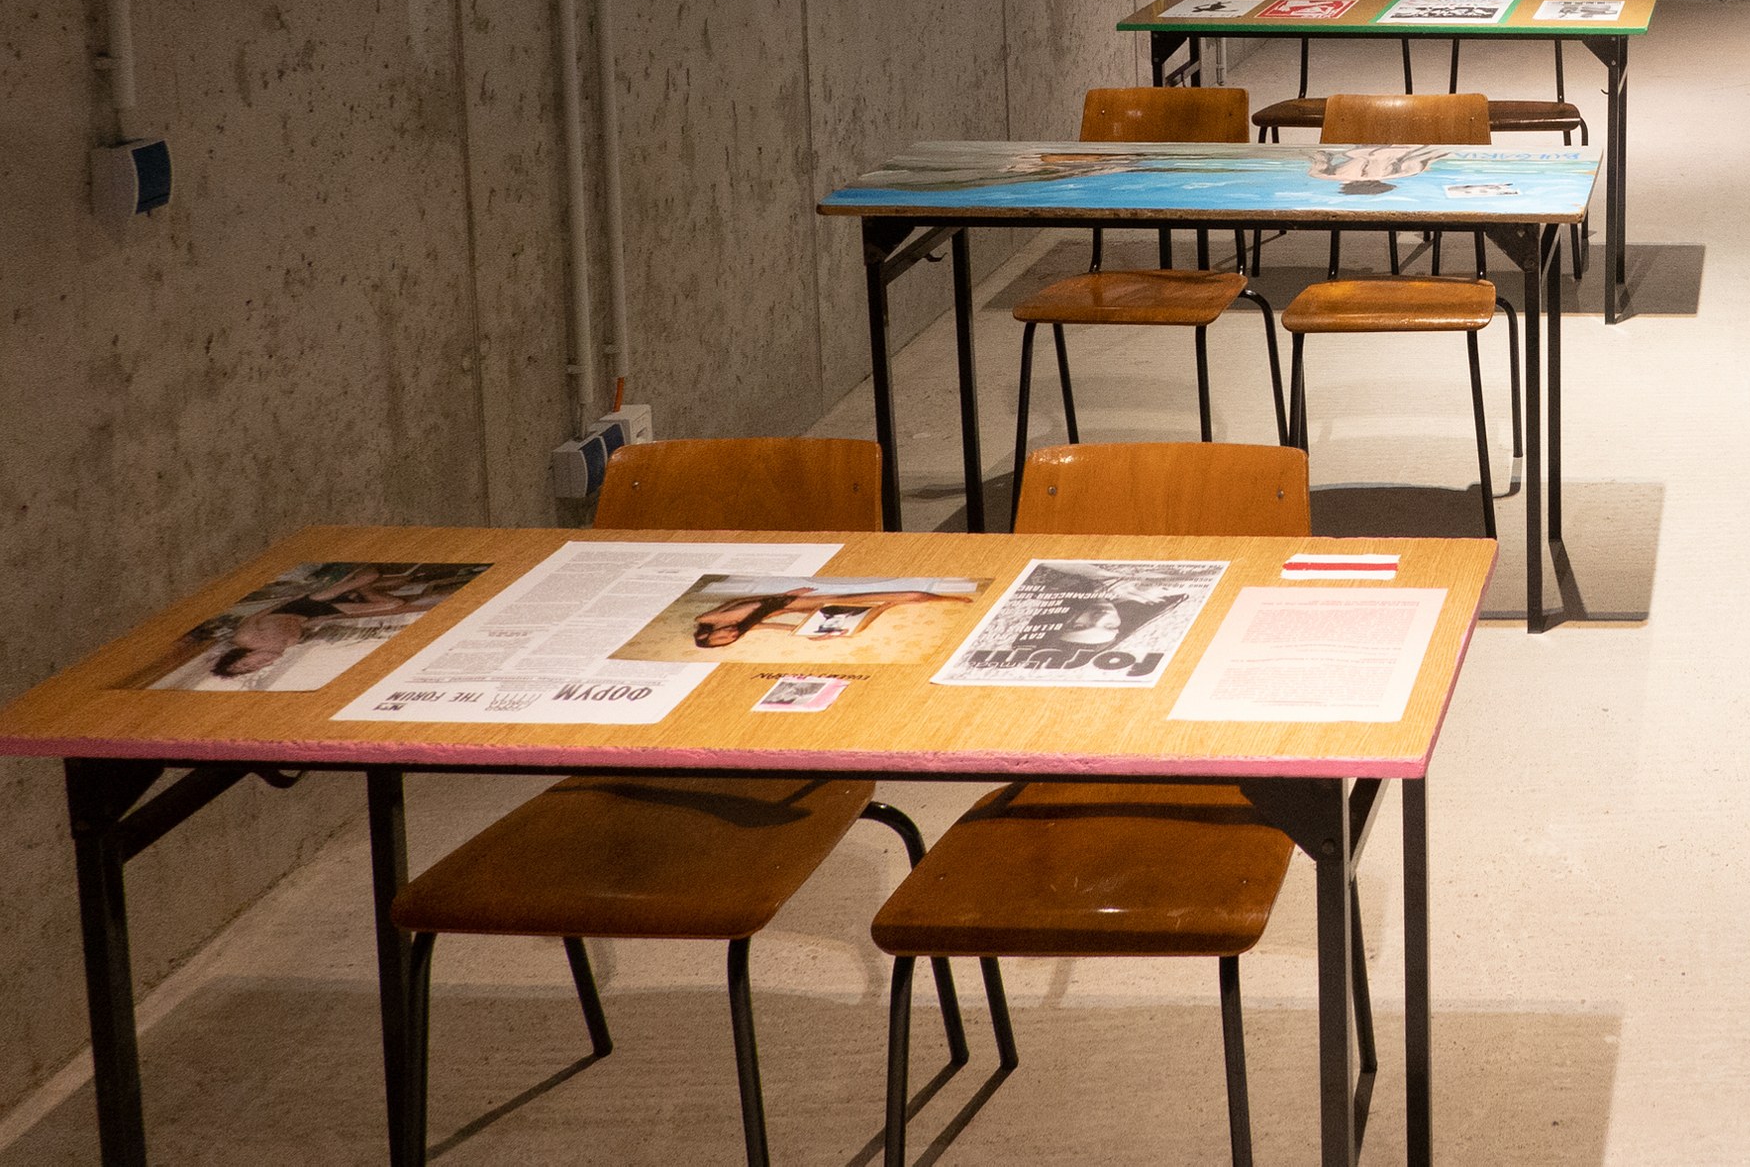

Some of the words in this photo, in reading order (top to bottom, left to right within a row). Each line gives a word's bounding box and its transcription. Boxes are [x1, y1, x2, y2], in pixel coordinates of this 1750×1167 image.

[968, 649, 1165, 677] forum
[385, 690, 445, 702] FORUM
[452, 692, 485, 703] THE
[552, 683, 653, 703] ФОРУМ
